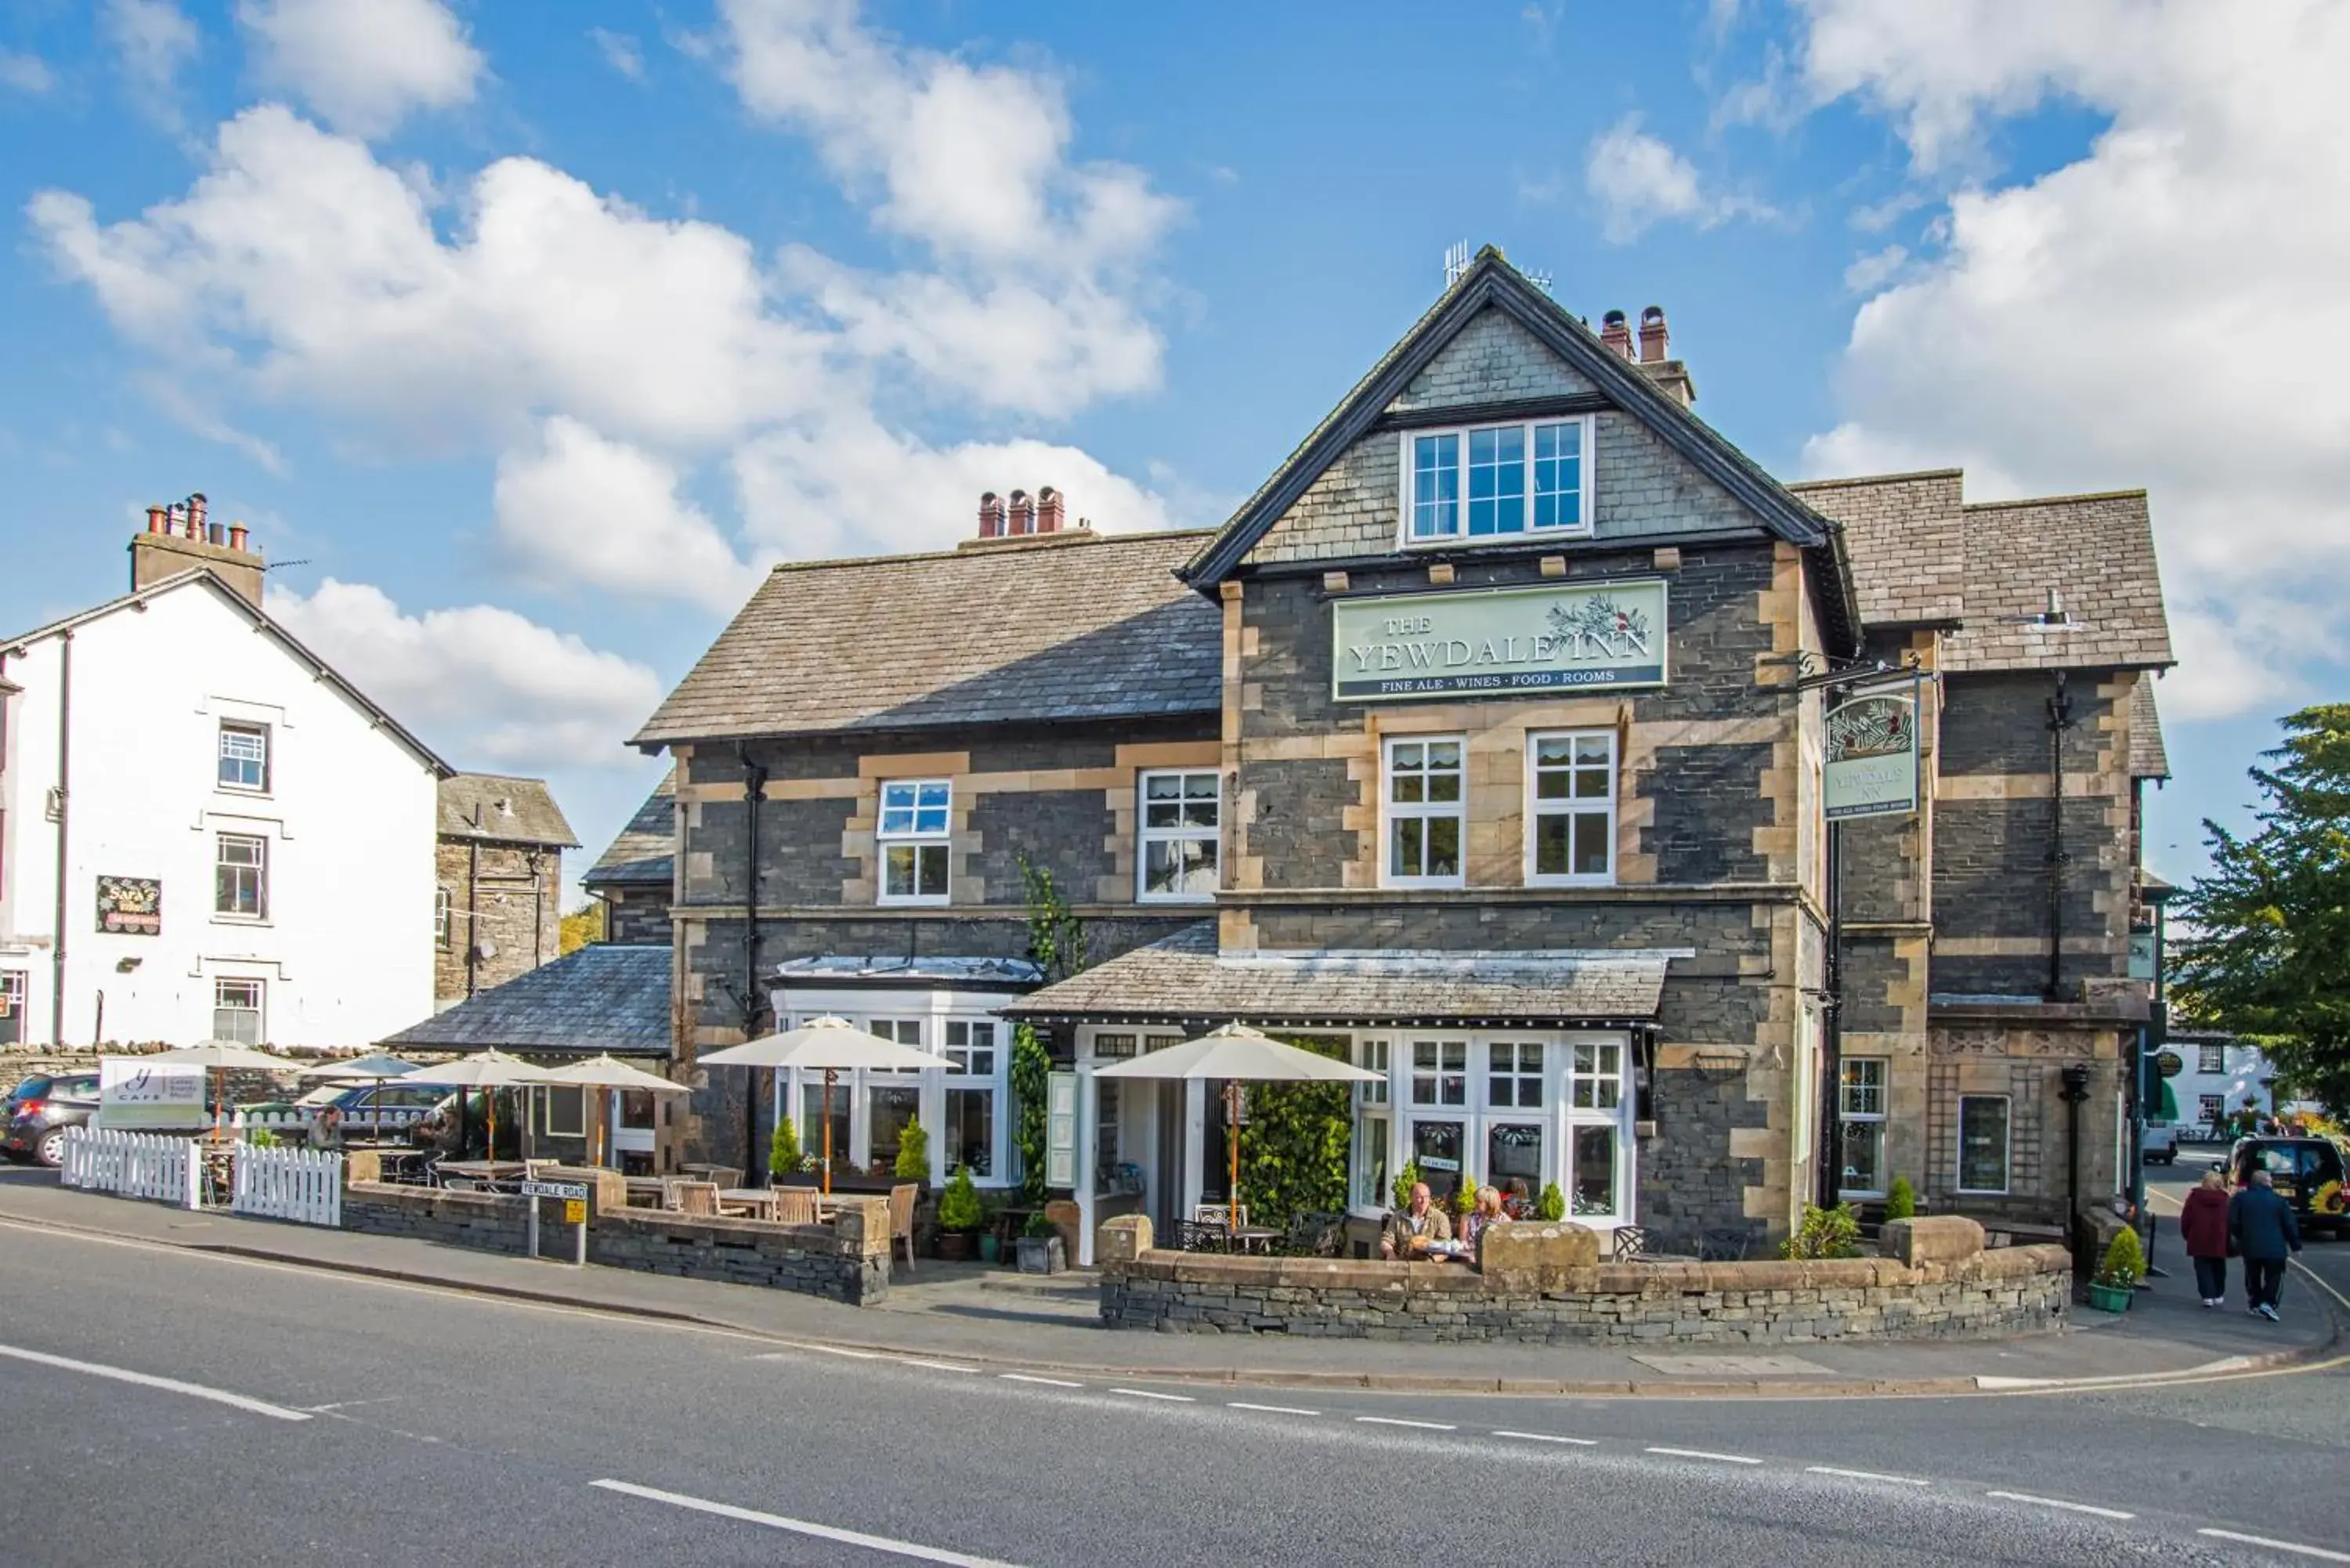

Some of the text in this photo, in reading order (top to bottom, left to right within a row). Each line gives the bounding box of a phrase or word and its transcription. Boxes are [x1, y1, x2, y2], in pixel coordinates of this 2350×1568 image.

[1384, 616, 1433, 636] THE
[1349, 629, 1650, 672] YEWDALE INN
[1381, 670, 1615, 692] FINE ALE WINES FOOD ROOMS
